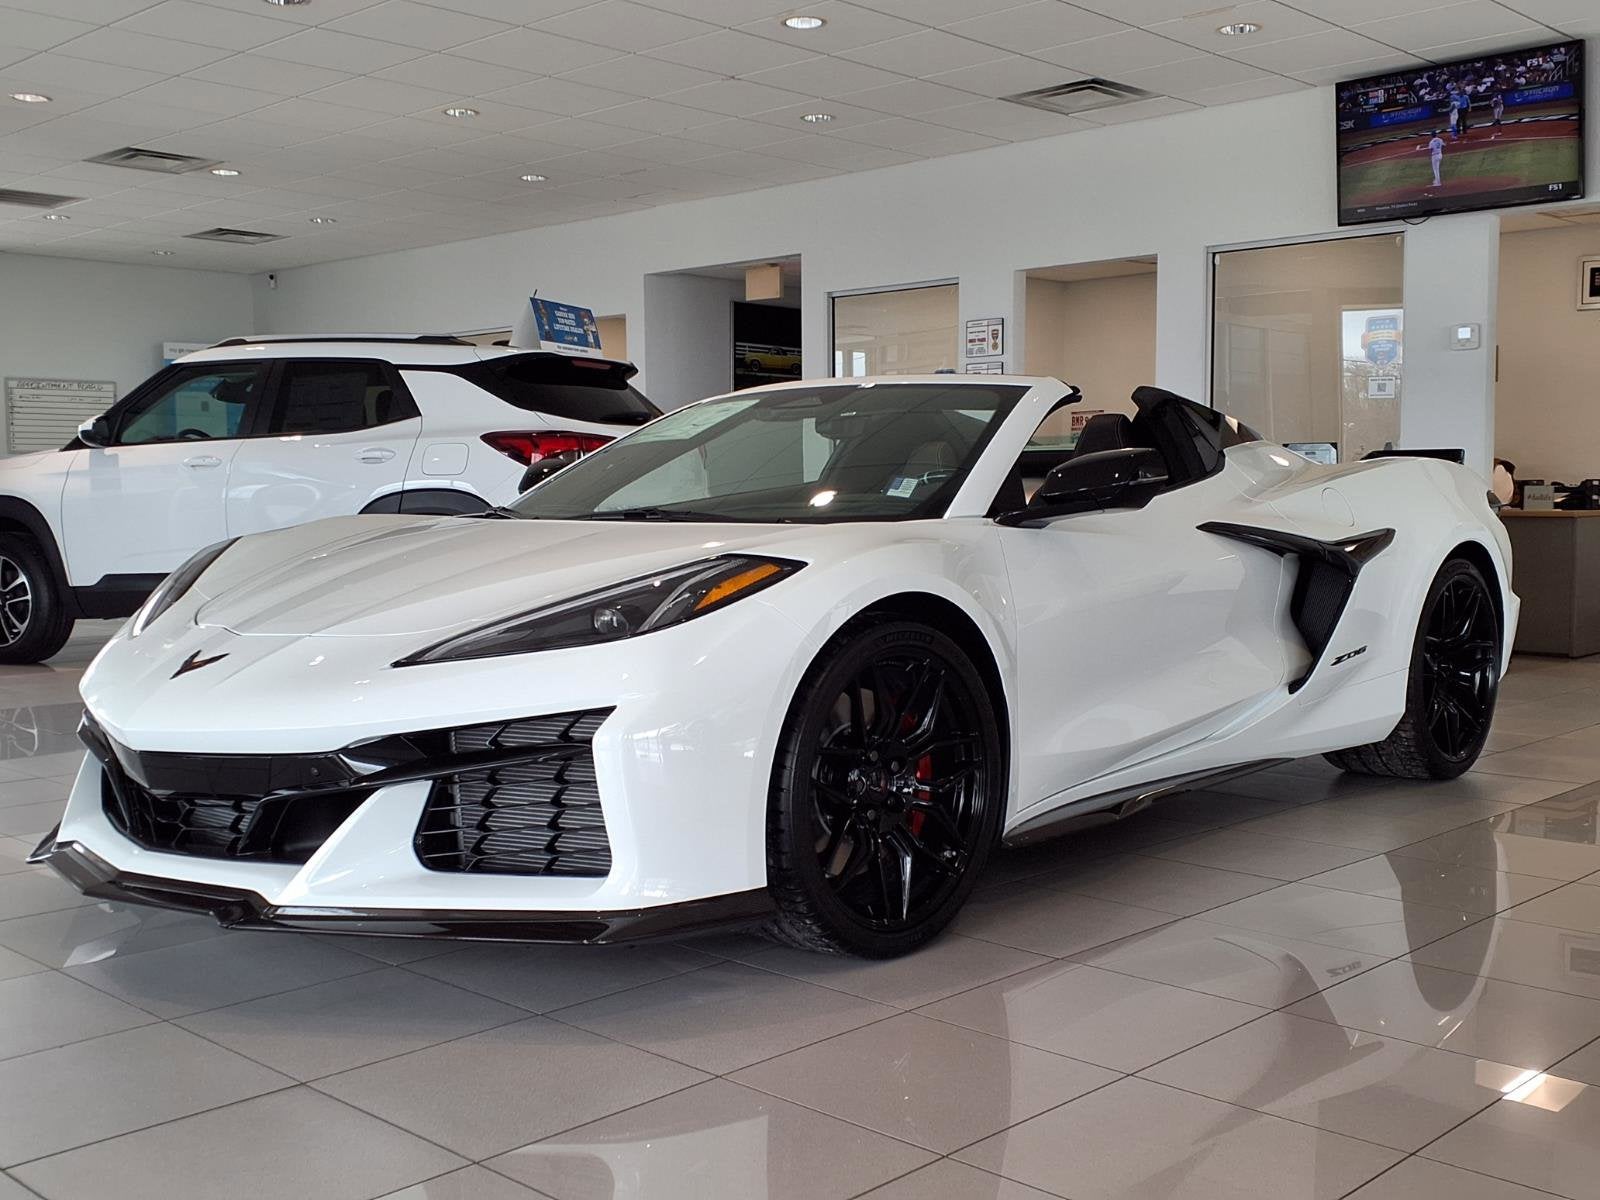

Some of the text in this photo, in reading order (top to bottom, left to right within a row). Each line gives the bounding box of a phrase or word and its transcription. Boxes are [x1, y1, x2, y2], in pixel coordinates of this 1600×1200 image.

[1527, 57, 1543, 67] FS1
[1548, 183, 1563, 191] FS1
[1329, 645, 1369, 667] Z06
